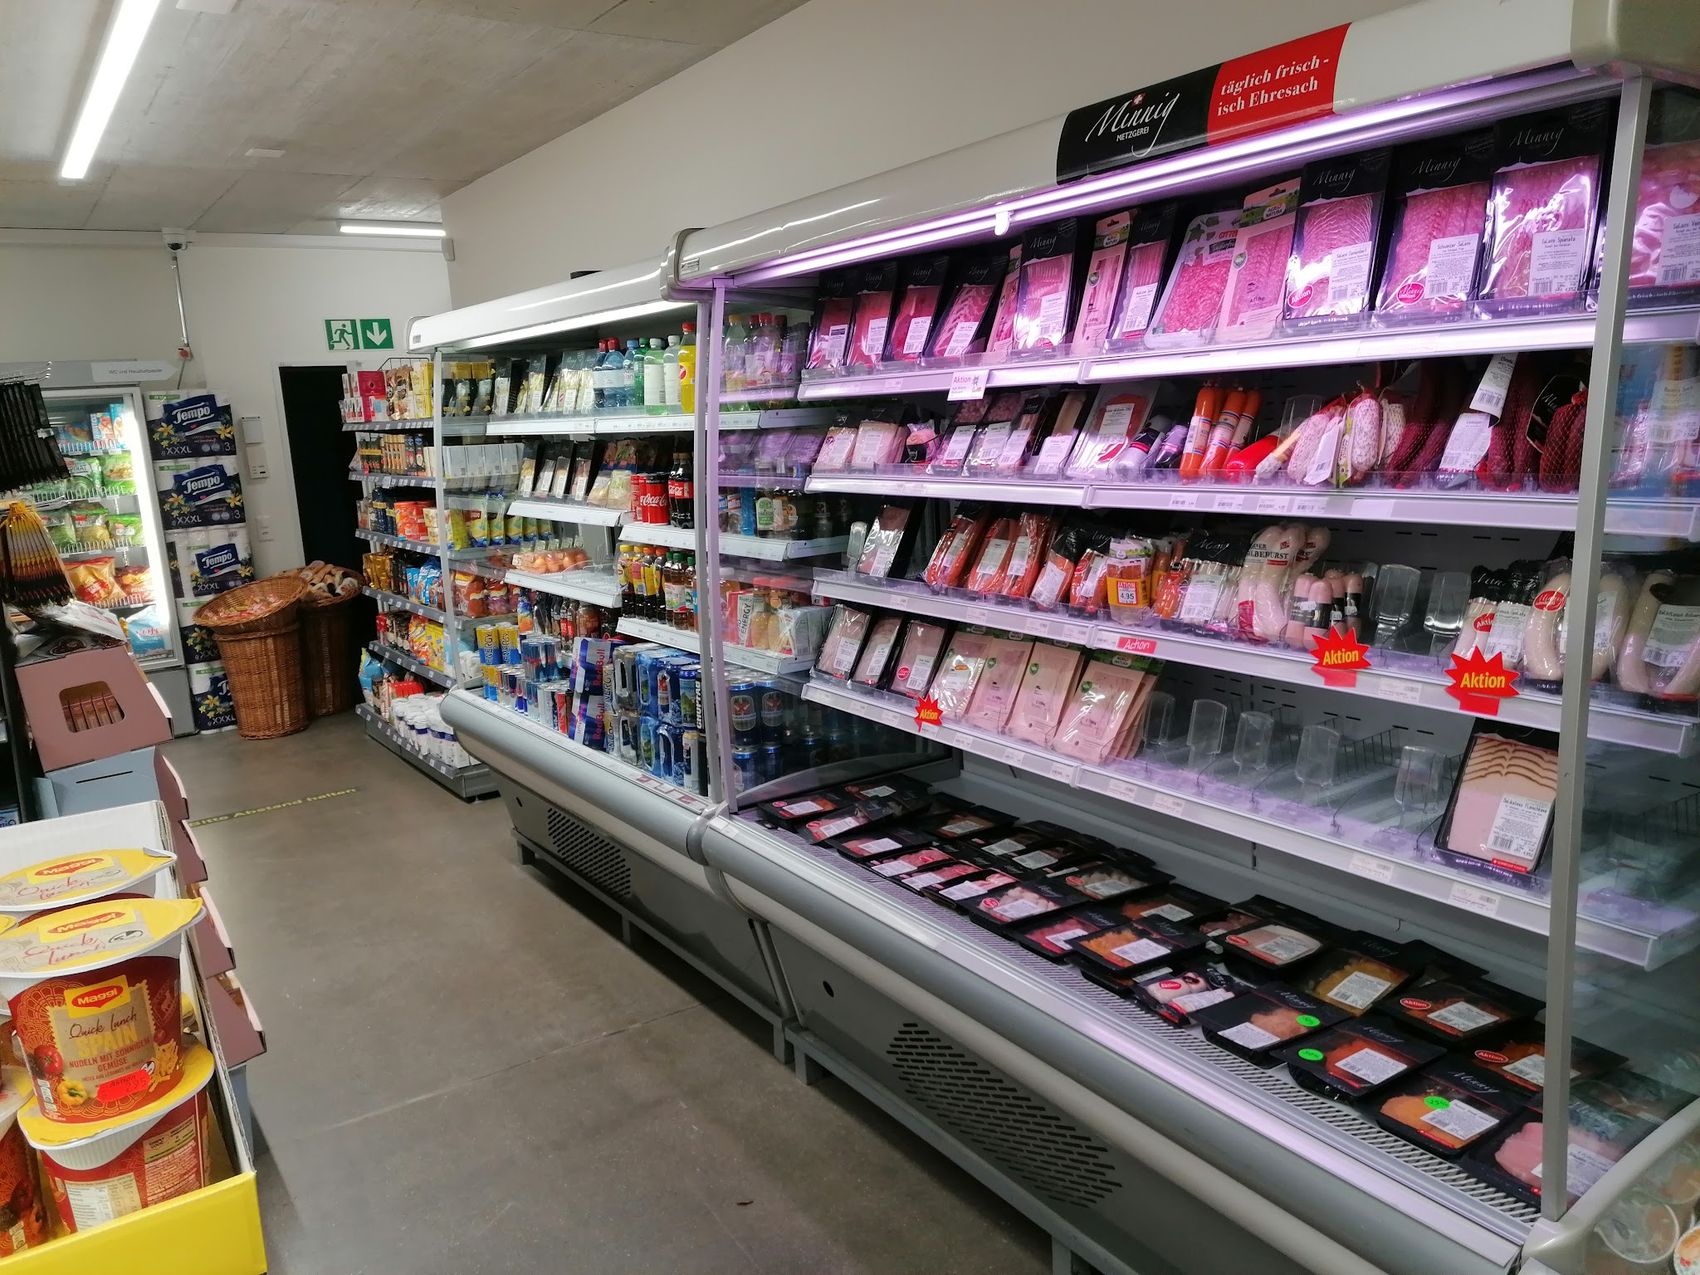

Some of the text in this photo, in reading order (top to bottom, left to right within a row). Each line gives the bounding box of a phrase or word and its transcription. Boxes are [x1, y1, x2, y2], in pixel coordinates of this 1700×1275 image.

[1221, 67, 1273, 97] täglich
[1274, 56, 1320, 82] frisch
[1217, 77, 1319, 117] isch Ehresach
[1085, 91, 1180, 158] Minnig
[1116, 126, 1150, 142] METZGEREI
[172, 403, 211, 425] Tempo
[167, 446, 193, 456] XXXL
[224, 441, 231, 452] 3
[182, 474, 221, 495] Tempo
[177, 515, 202, 525] XXXL
[233, 509, 241, 519] 3
[202, 552, 233, 569] Tempo
[1322, 648, 1360, 666] Aktion
[1460, 672, 1506, 689] Aktion
[919, 708, 938, 721] Aktion
[42, 857, 96, 876] Maggi
[56, 912, 117, 933] Maggi
[77, 988, 118, 1006] Maggi
[1404, 999, 1428, 1008] Aktion
[69, 1007, 137, 1040] Quick Lunch
[77, 1022, 138, 1058] SPAIN
[68, 1037, 151, 1068] NUDELN MIT SONNIGEM
